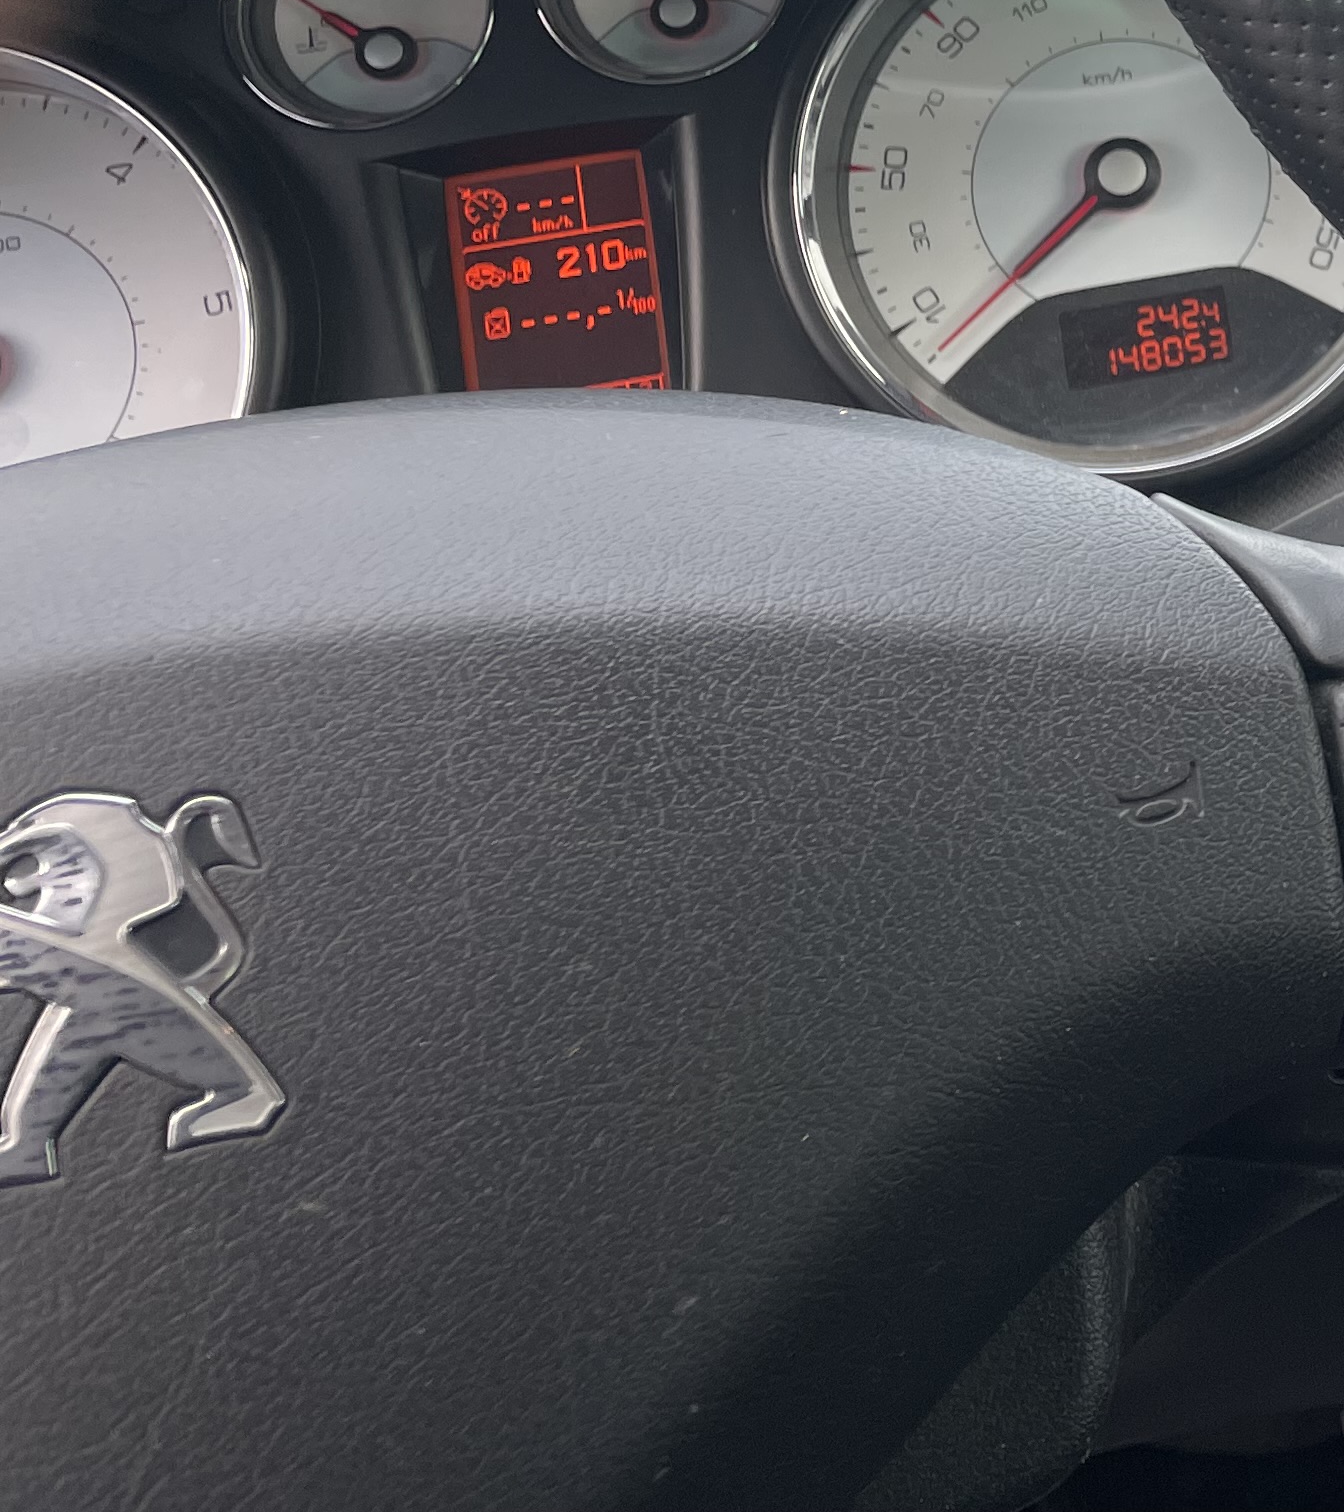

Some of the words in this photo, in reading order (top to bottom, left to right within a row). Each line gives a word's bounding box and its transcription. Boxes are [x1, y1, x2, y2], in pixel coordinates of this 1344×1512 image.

[936, 16, 980, 60] 90
[1082, 65, 1133, 87] km/h
[919, 88, 945, 120] 70
[104, 162, 134, 186] 4
[881, 145, 908, 191] 50
[472, 221, 500, 243] off
[532, 214, 574, 234] km/h
[908, 220, 932, 253] 30
[1308, 215, 1342, 271] 50
[556, 239, 626, 279] 210
[625, 246, 648, 262] km
[203, 289, 233, 317] 5
[912, 286, 946, 325] 10
[1136, 298, 1221, 338] 242.4
[1108, 328, 1229, 377] 148053
